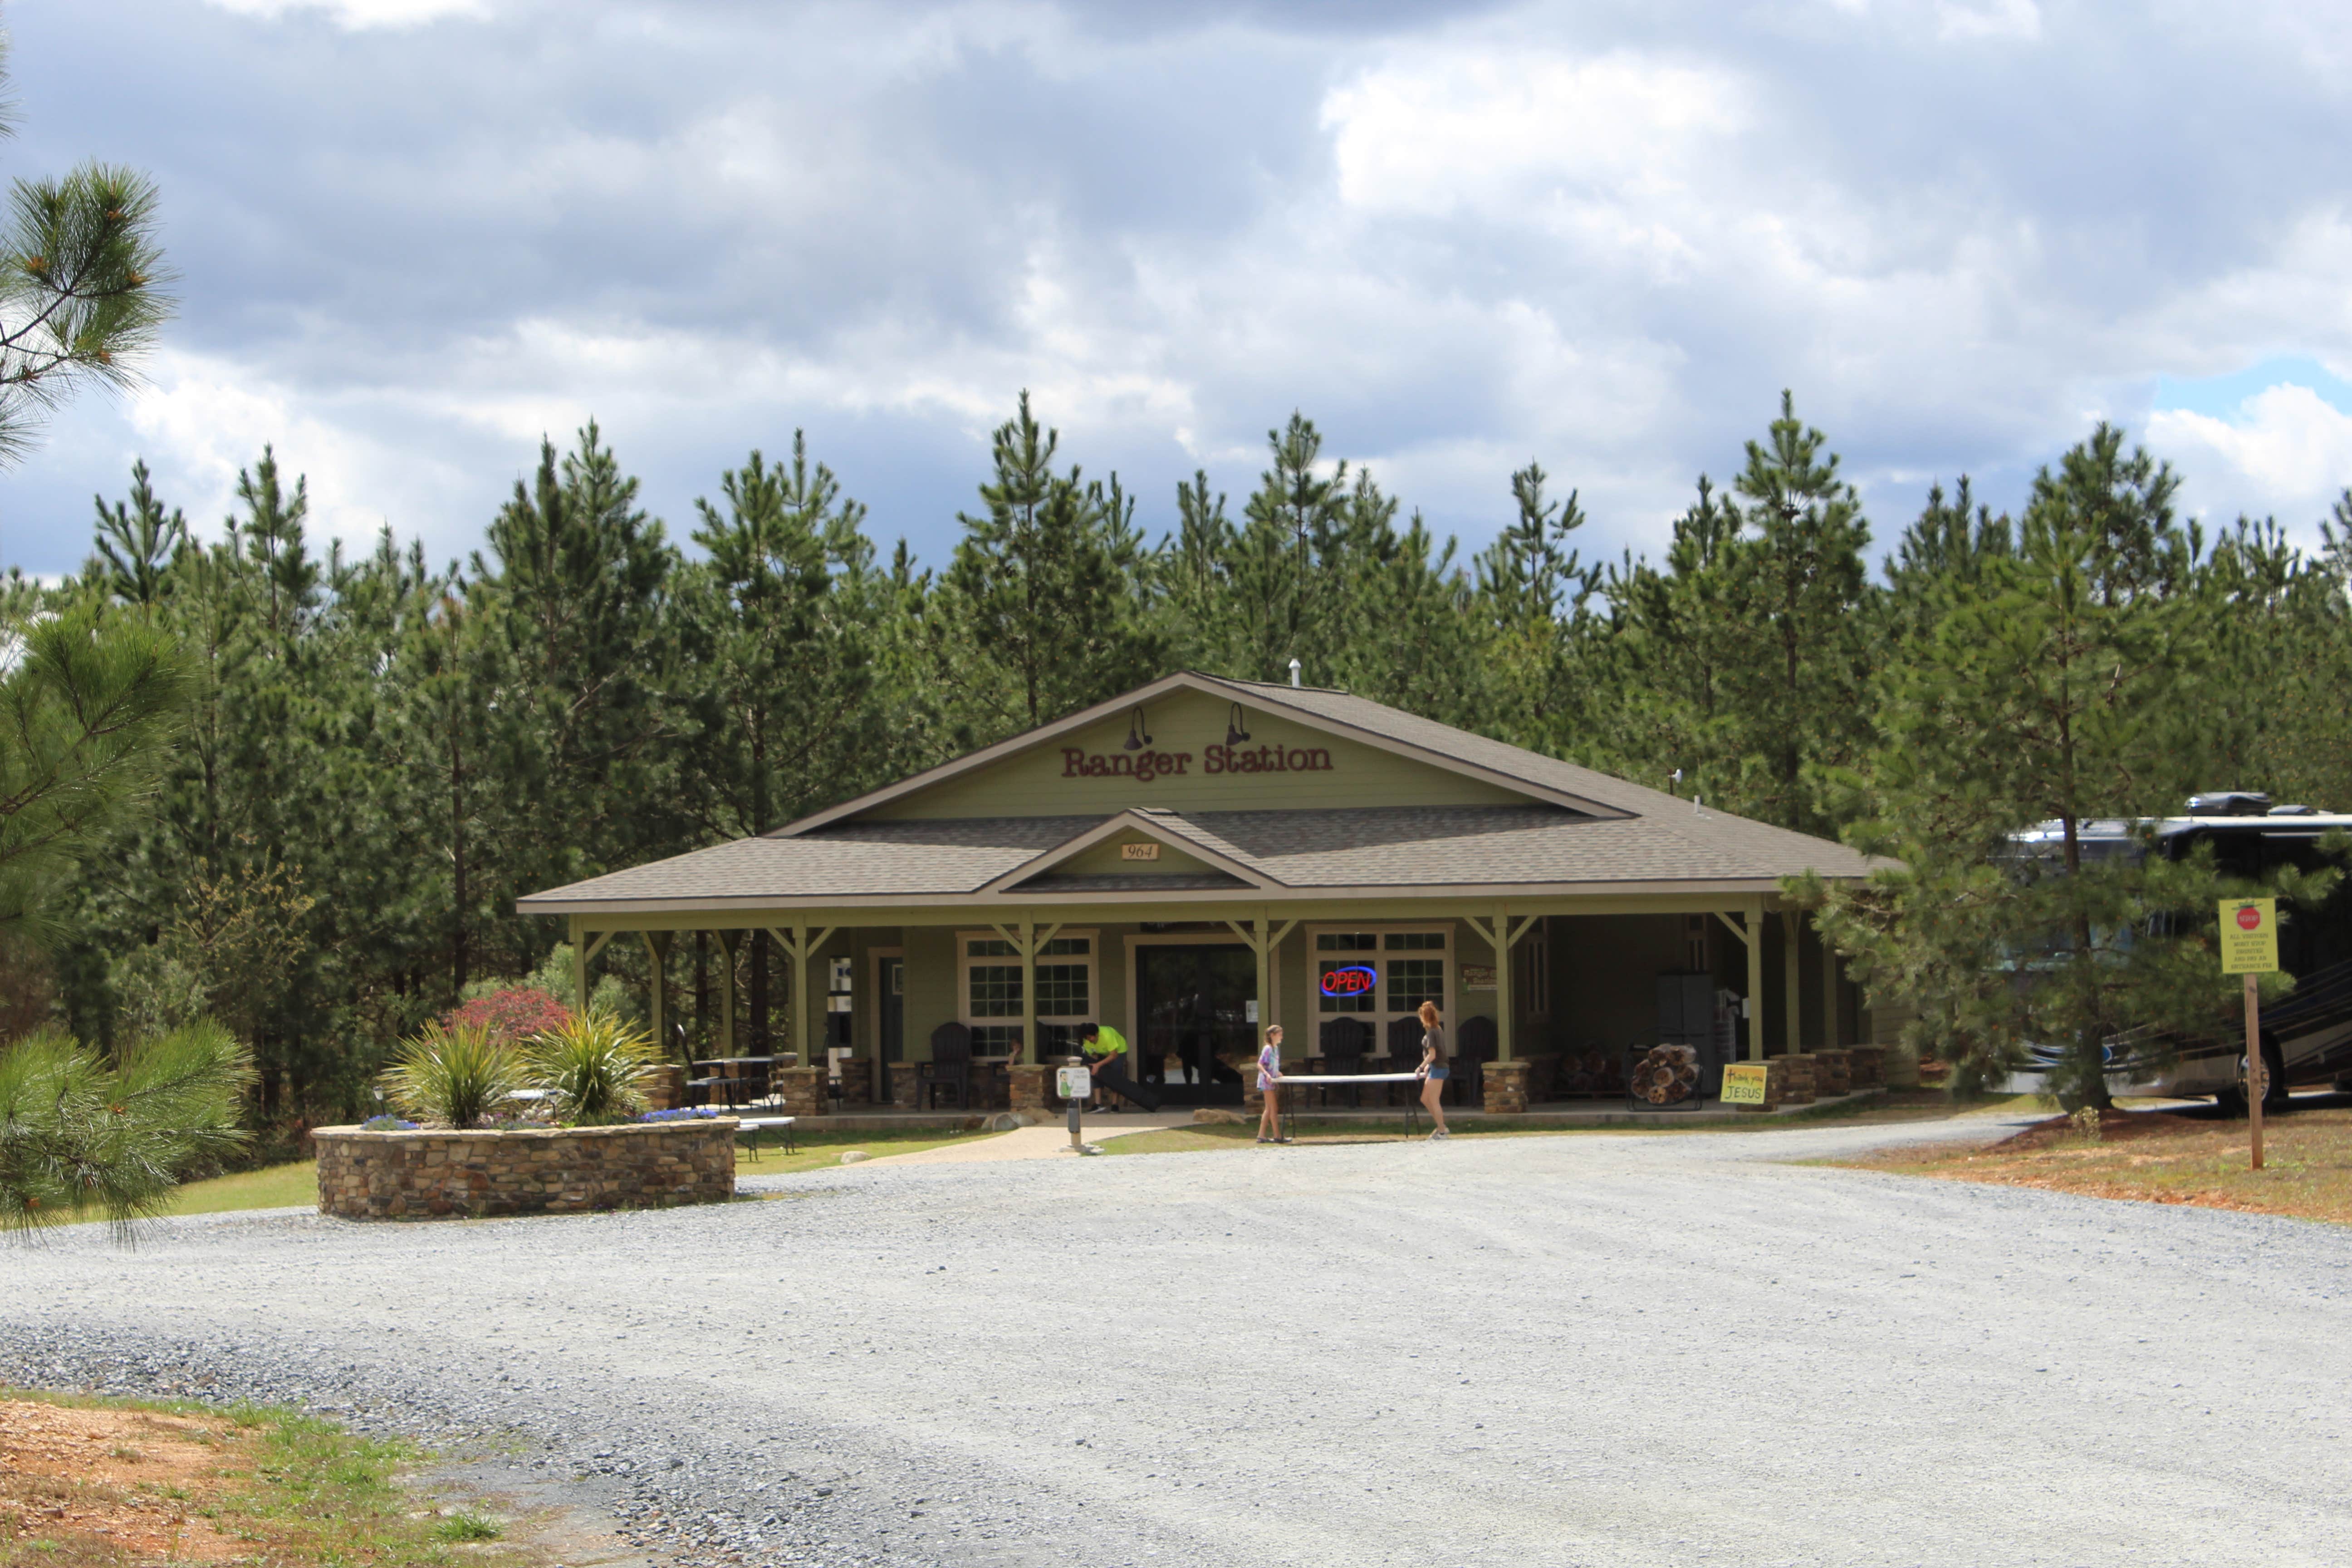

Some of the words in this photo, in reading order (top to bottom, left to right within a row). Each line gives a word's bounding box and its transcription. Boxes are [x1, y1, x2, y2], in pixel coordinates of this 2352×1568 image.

[1060, 748, 1192, 782] Ranger
[1204, 744, 1333, 774] Station
[1127, 844, 1153, 858] 964
[1322, 971, 1371, 992] OPEN
[1725, 1086, 1762, 1099] JESUS
